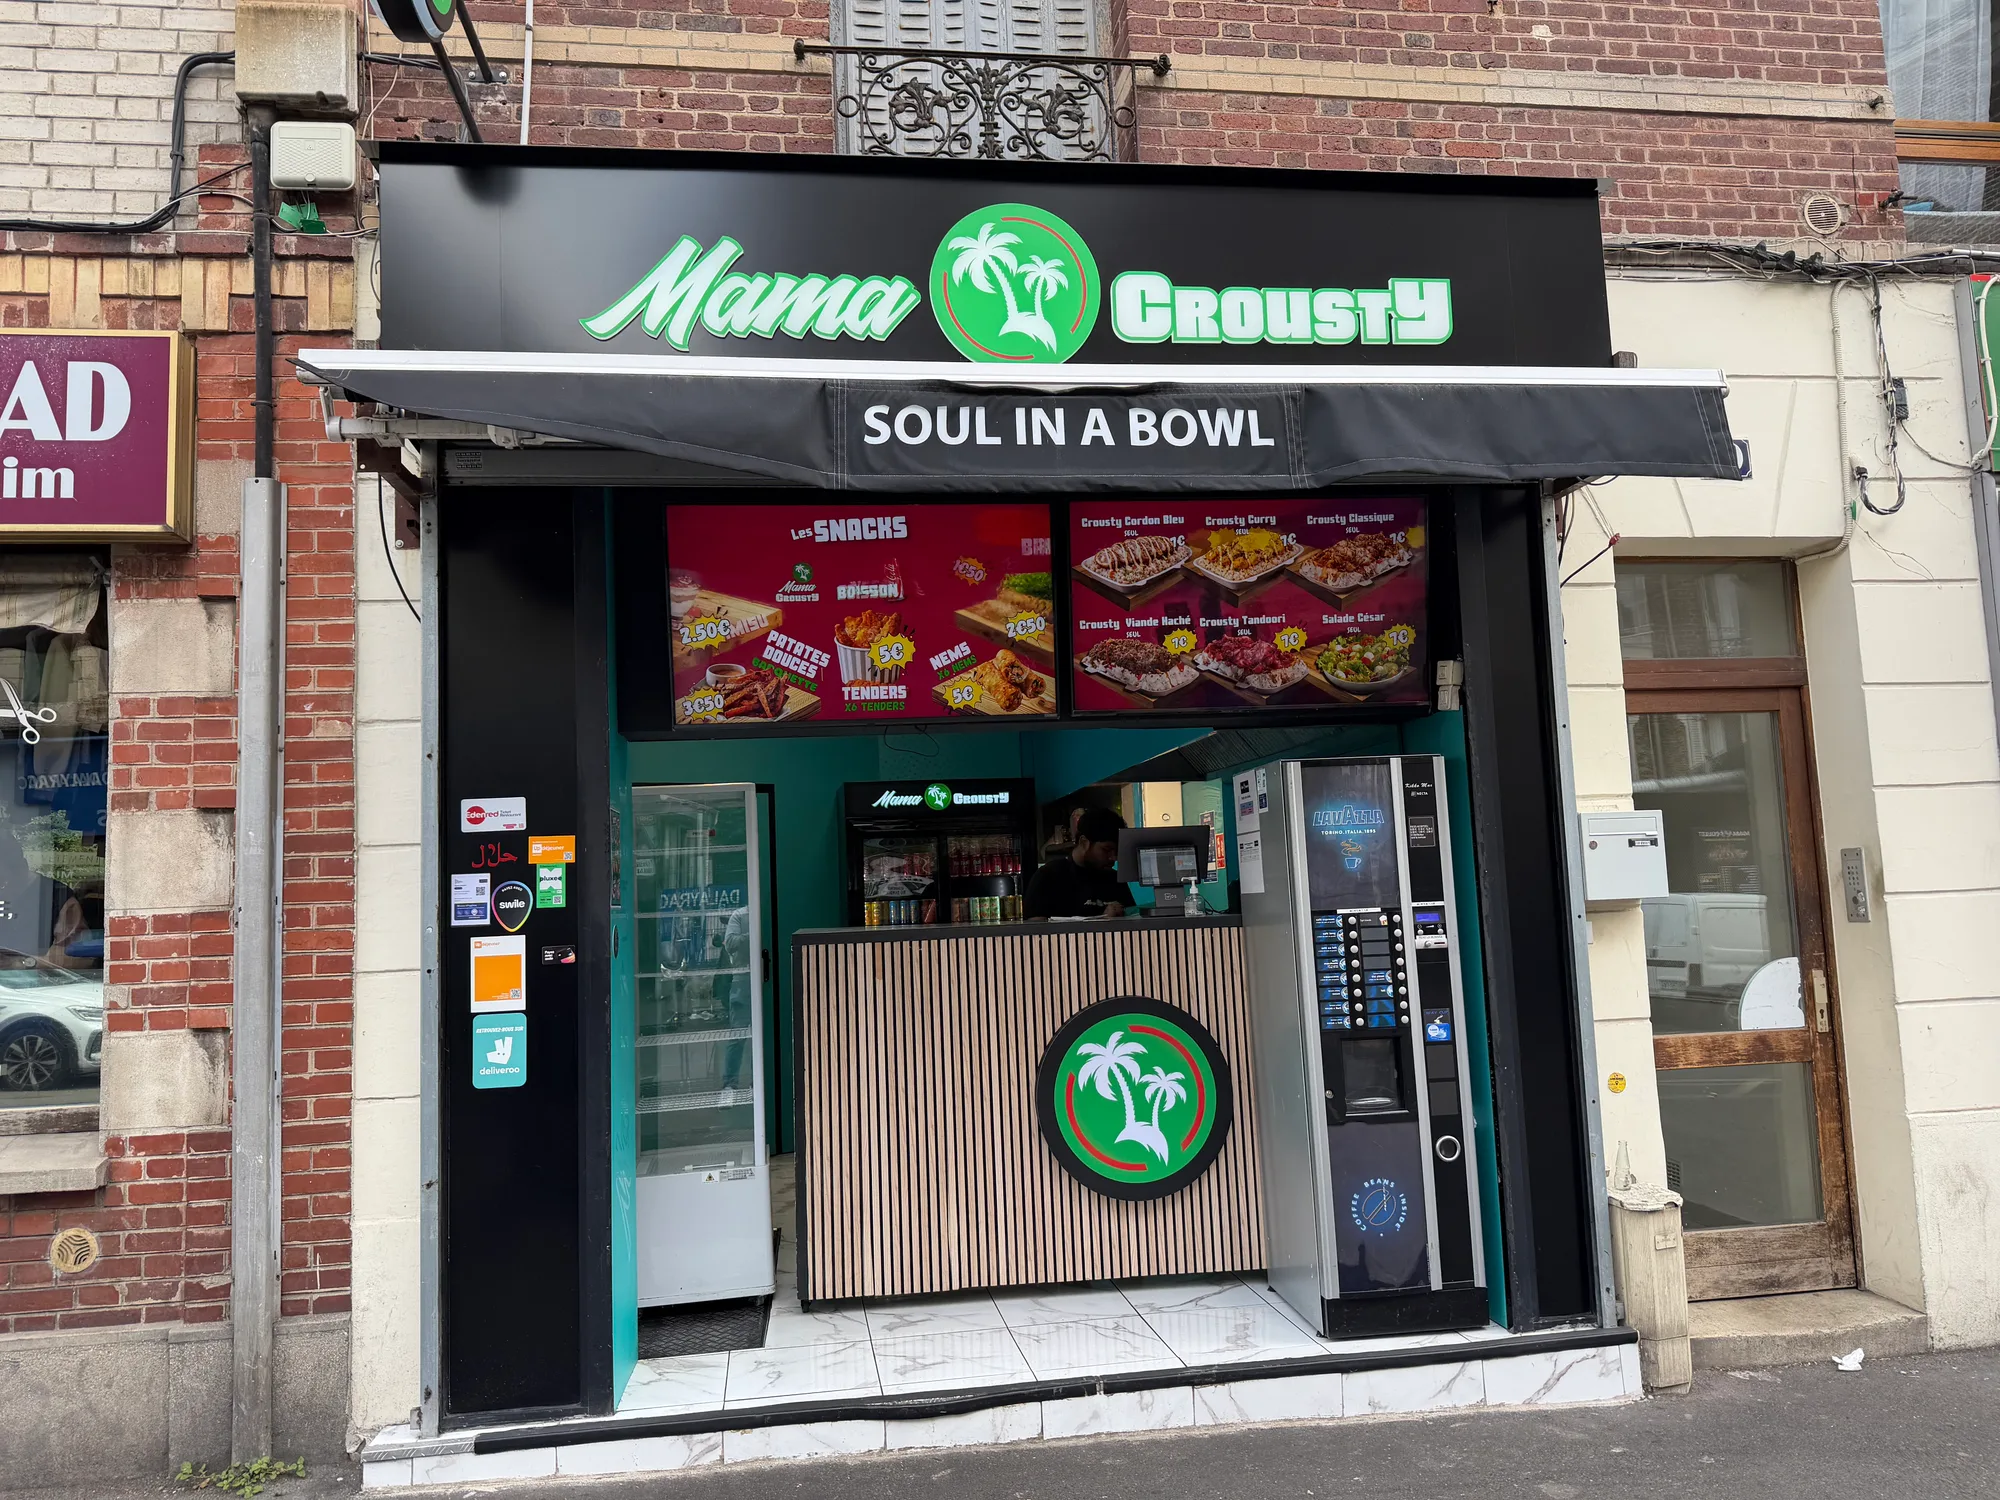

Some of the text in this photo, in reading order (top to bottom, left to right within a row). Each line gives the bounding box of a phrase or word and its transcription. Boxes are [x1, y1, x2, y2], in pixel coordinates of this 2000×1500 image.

[578, 234, 922, 353] Mama
[863, 405, 1275, 448] SOUL IN A BOWL
[1081, 514, 1185, 529] Crousty Cordon Bleu
[1205, 514, 1277, 526] Crousty Curry
[1307, 512, 1395, 525] Crousty Classique
[791, 515, 908, 542] Les SNACKS
[778, 580, 817, 593] Mama
[726, 614, 769, 640] MISU
[1005, 616, 1046, 638] 2€50
[1079, 615, 1191, 631] Crousty Viande Haché
[1199, 614, 1286, 629] Crousty Tandoori
[1322, 612, 1386, 624] Salade César
[679, 618, 731, 645] 2.50€
[767, 629, 831, 668] PATATES
[878, 642, 904, 664] 5€
[929, 641, 972, 671] NEMS
[762, 645, 818, 679] DOUCES
[952, 655, 977, 673] NEMS
[842, 685, 907, 701] TENDERS
[952, 686, 974, 705] 5€
[682, 693, 724, 716] 3€50
[862, 701, 905, 711] TENDERS
[872, 790, 924, 808] Mama
[1312, 804, 1385, 827] LAVAZZA
[499, 899, 525, 909] swile
[479, 1066, 520, 1075] deliveroo
[1351, 1178, 1408, 1231] COFFEE BEANS INSIDE
